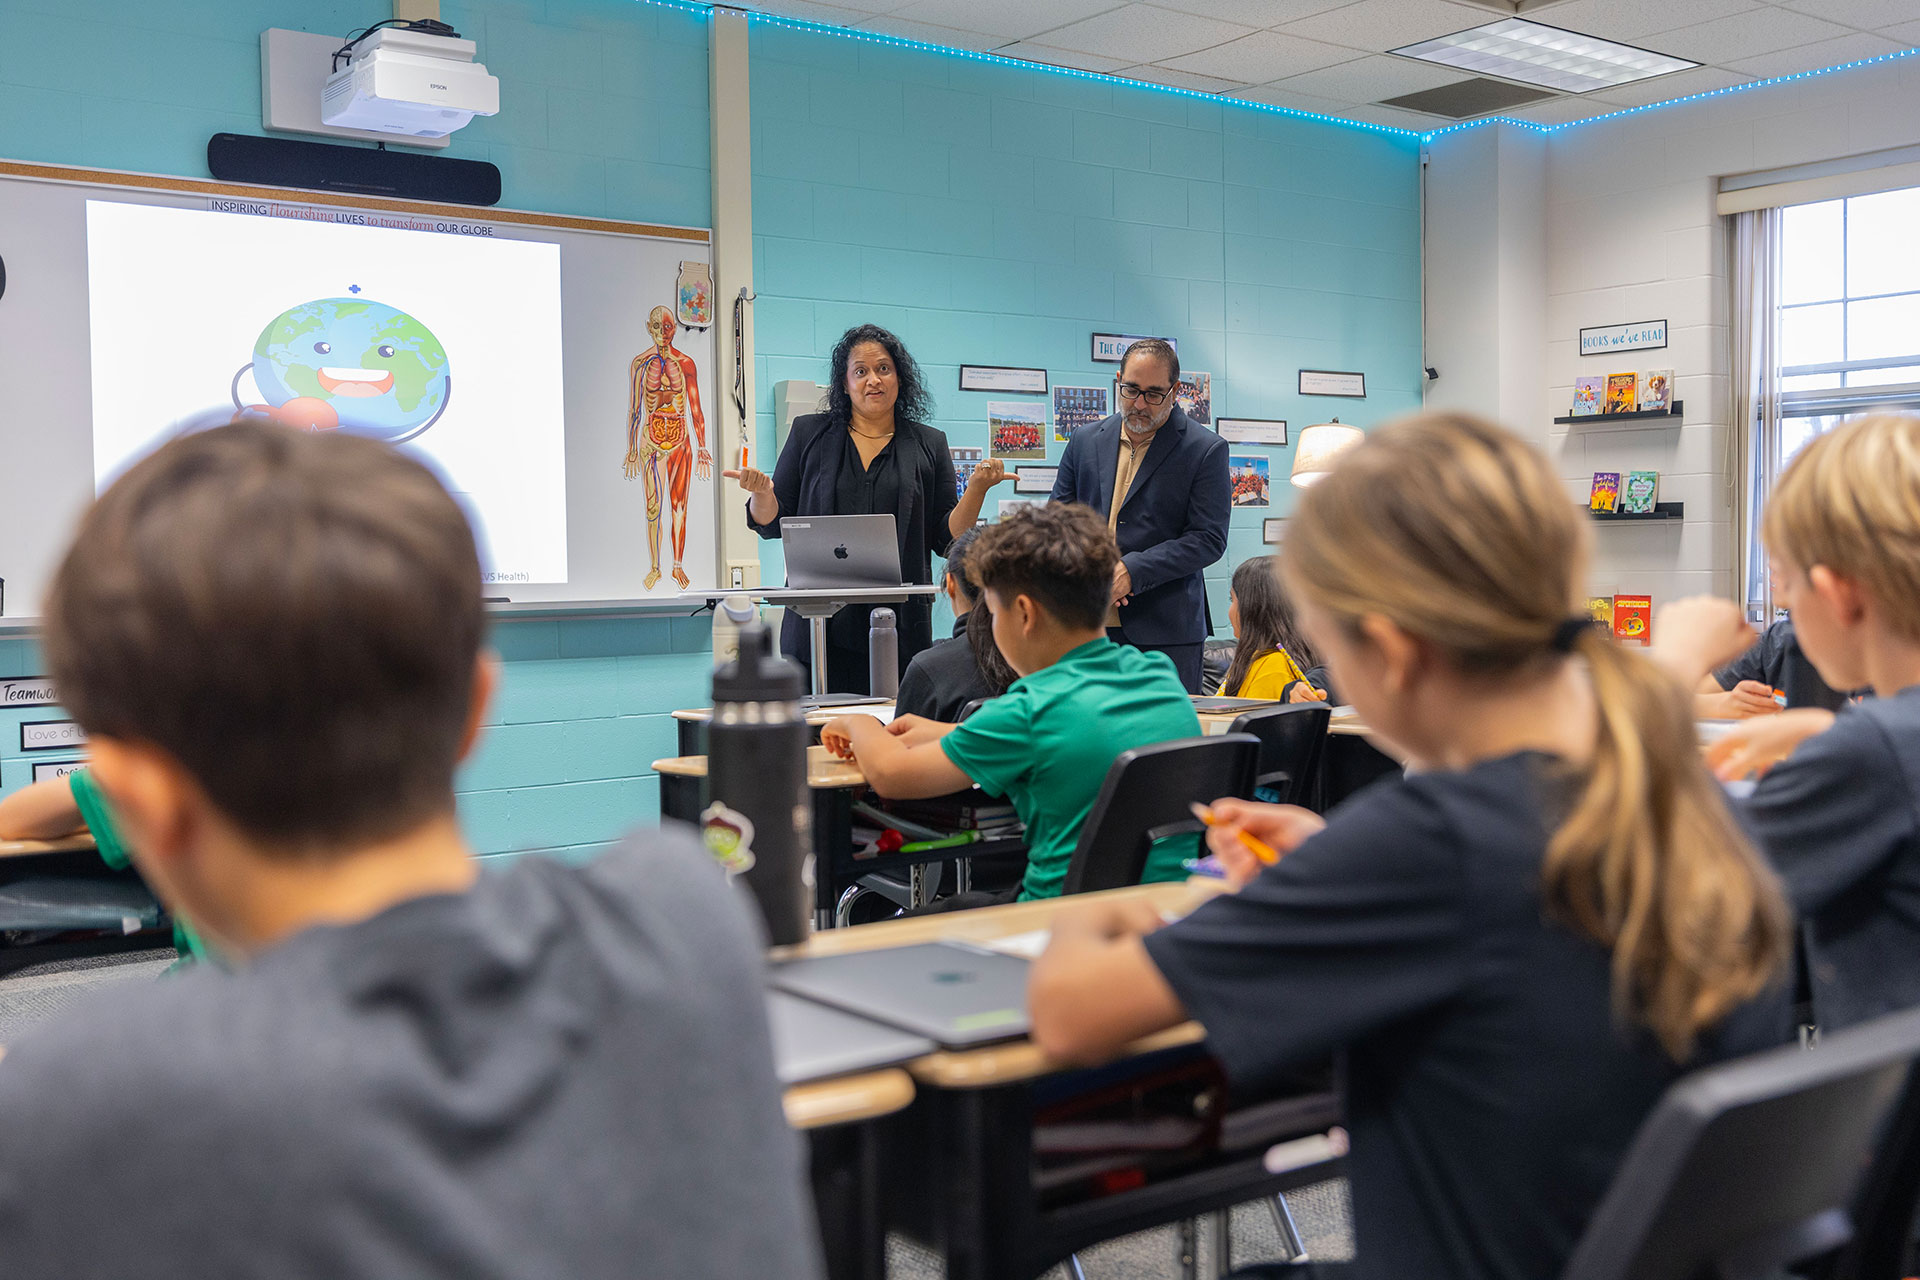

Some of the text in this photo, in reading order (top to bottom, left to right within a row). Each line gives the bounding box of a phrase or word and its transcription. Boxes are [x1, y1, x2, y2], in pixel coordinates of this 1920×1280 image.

[211, 201, 493, 236] INSPIRING flourishing LIVES to transform OUR GLOBE
[1583, 329, 1663, 348] BOOKS we've READ
[1099, 341, 1114, 355] THE
[497, 571, 530, 582] Health)
[4, 684, 56, 701] Teamwo
[28, 729, 57, 740] Love
[61, 727, 74, 738] of
